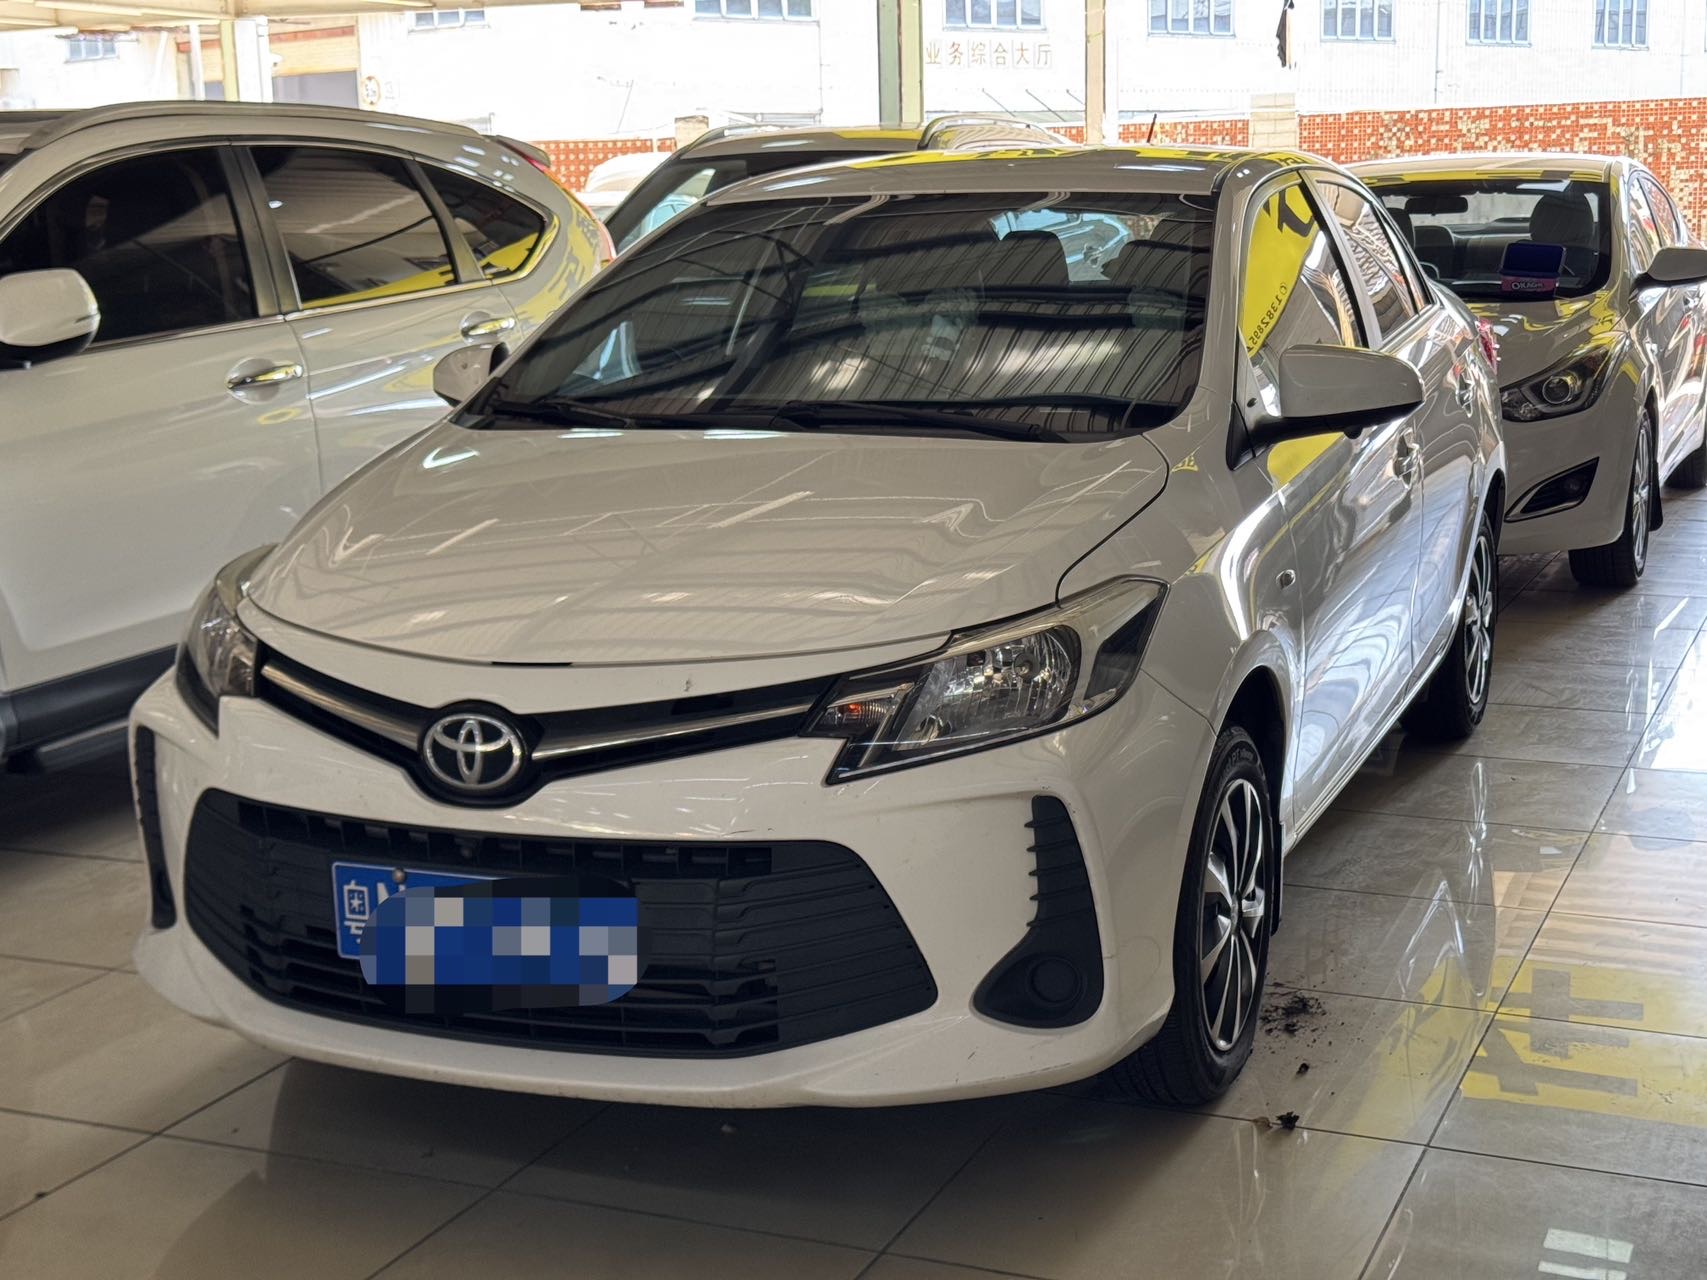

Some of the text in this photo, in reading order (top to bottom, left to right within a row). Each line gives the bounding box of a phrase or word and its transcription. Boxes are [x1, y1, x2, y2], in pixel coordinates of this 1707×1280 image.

[925, 41, 1052, 66] 业务综合大厅
